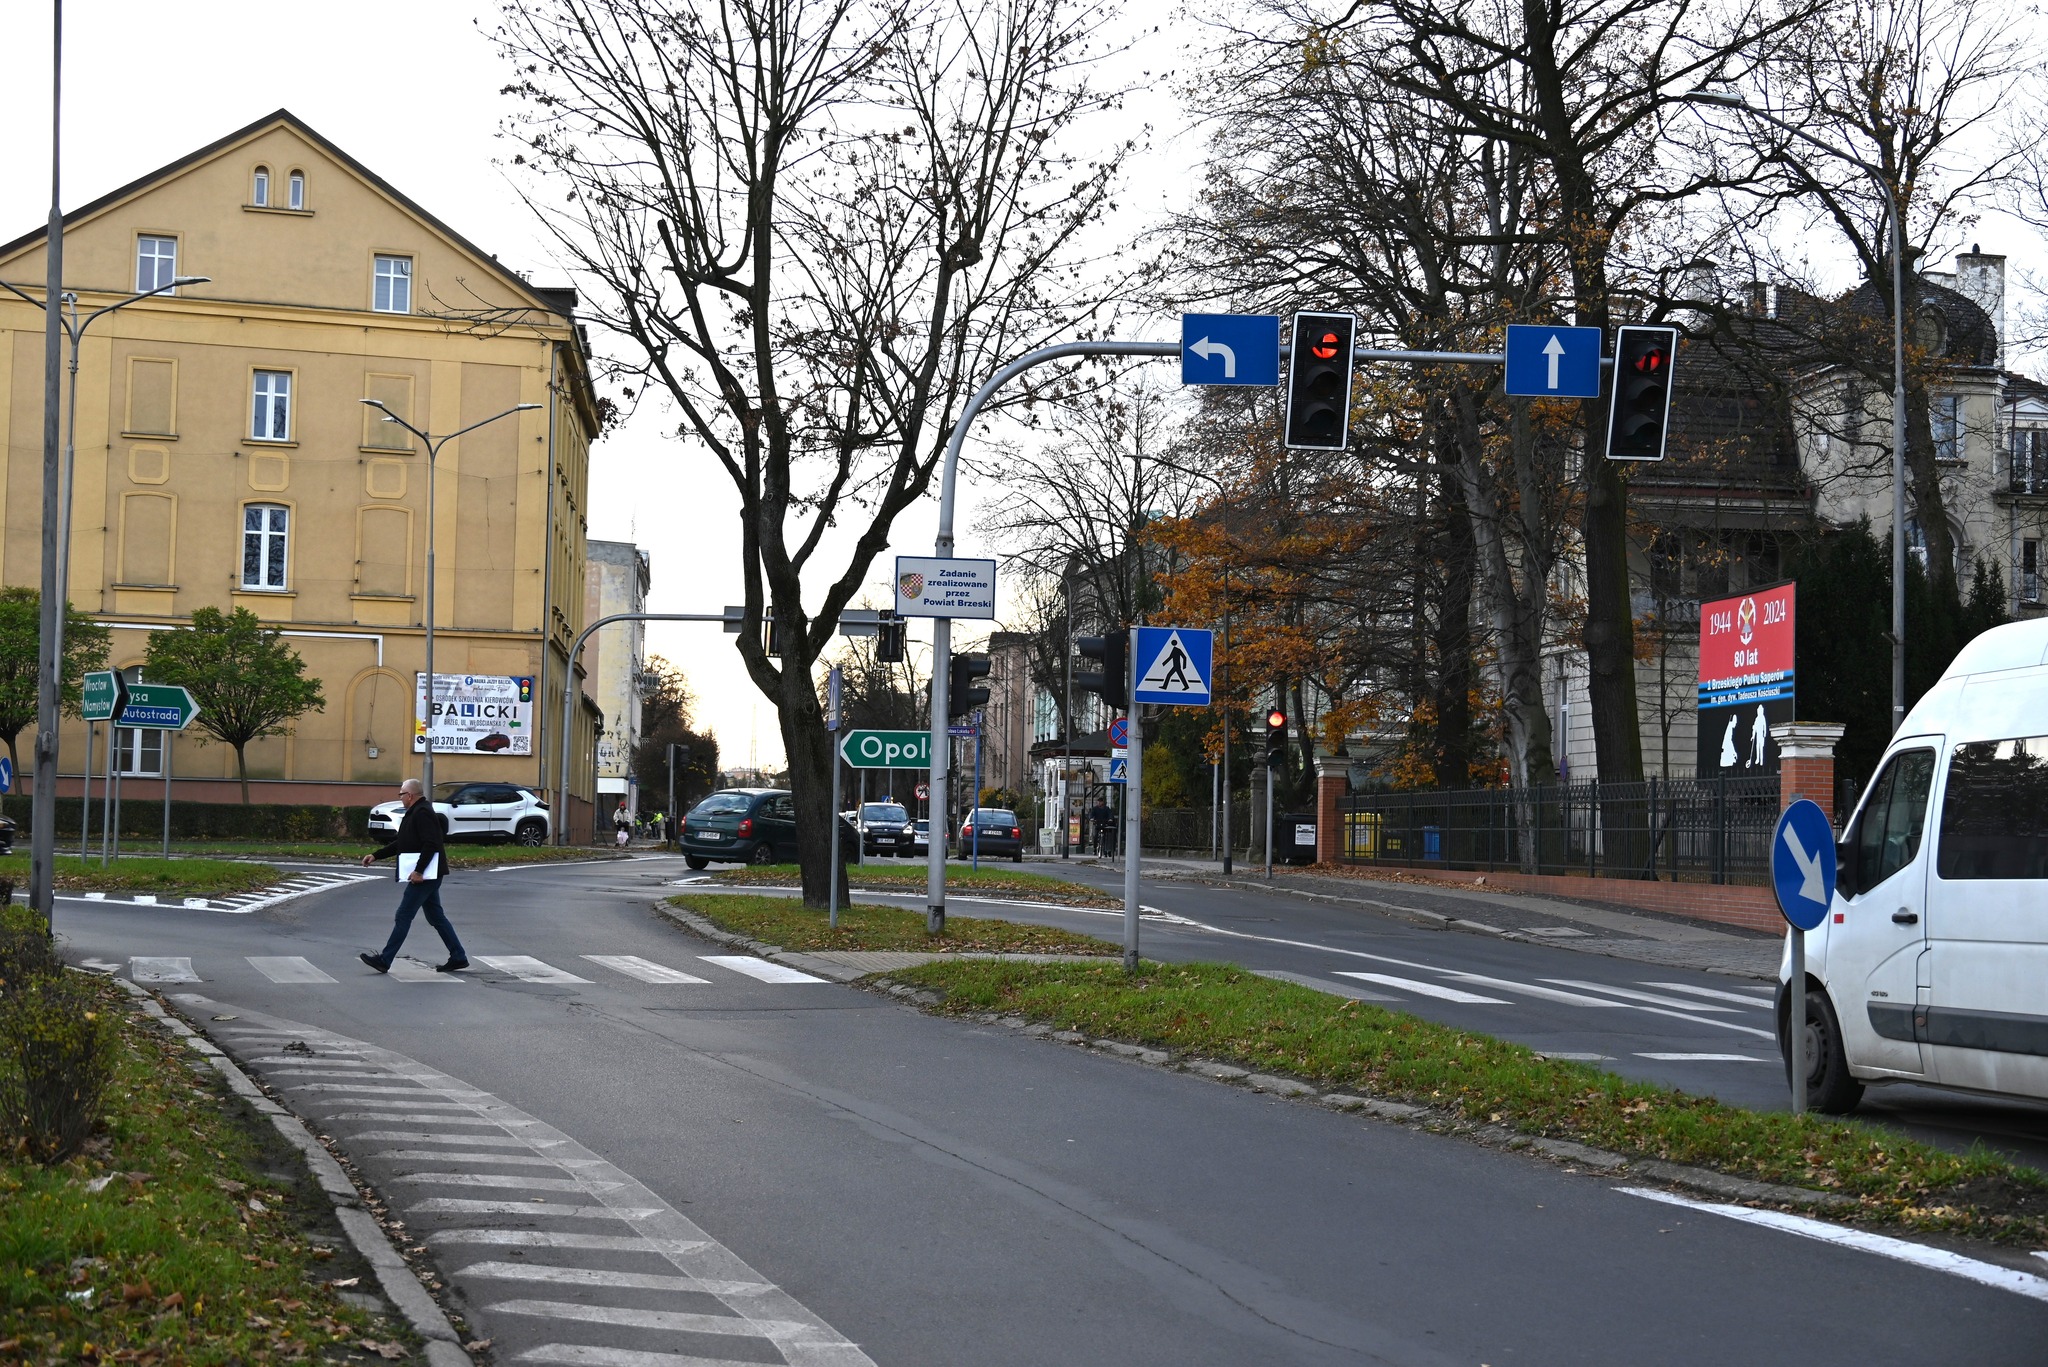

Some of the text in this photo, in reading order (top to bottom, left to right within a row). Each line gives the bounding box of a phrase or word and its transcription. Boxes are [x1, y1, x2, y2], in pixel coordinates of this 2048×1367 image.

[939, 569, 977, 578] Zadanie
[927, 579, 988, 588] zrealizowane
[945, 590, 970, 598] przez
[923, 598, 992, 608] Powiat Brzeski
[1709, 598, 1786, 635] 1944 2024
[1734, 648, 1758, 668] 80 lat
[85, 679, 107, 692] Wrocław
[1707, 668, 1785, 691] 1 Brzeskiego Pułku Saperów
[129, 692, 149, 704] ysa
[458, 695, 484, 703] SZKOLENIA
[484, 696, 514, 704] KIEROWCÓW
[1738, 691, 1758, 700] Tadeusza
[84, 698, 111, 715] Namysłów
[432, 703, 517, 719] BALICKI
[122, 707, 179, 720] Autostrada
[441, 737, 454, 746] 370
[456, 737, 469, 746] 102
[860, 736, 932, 765] Opol
